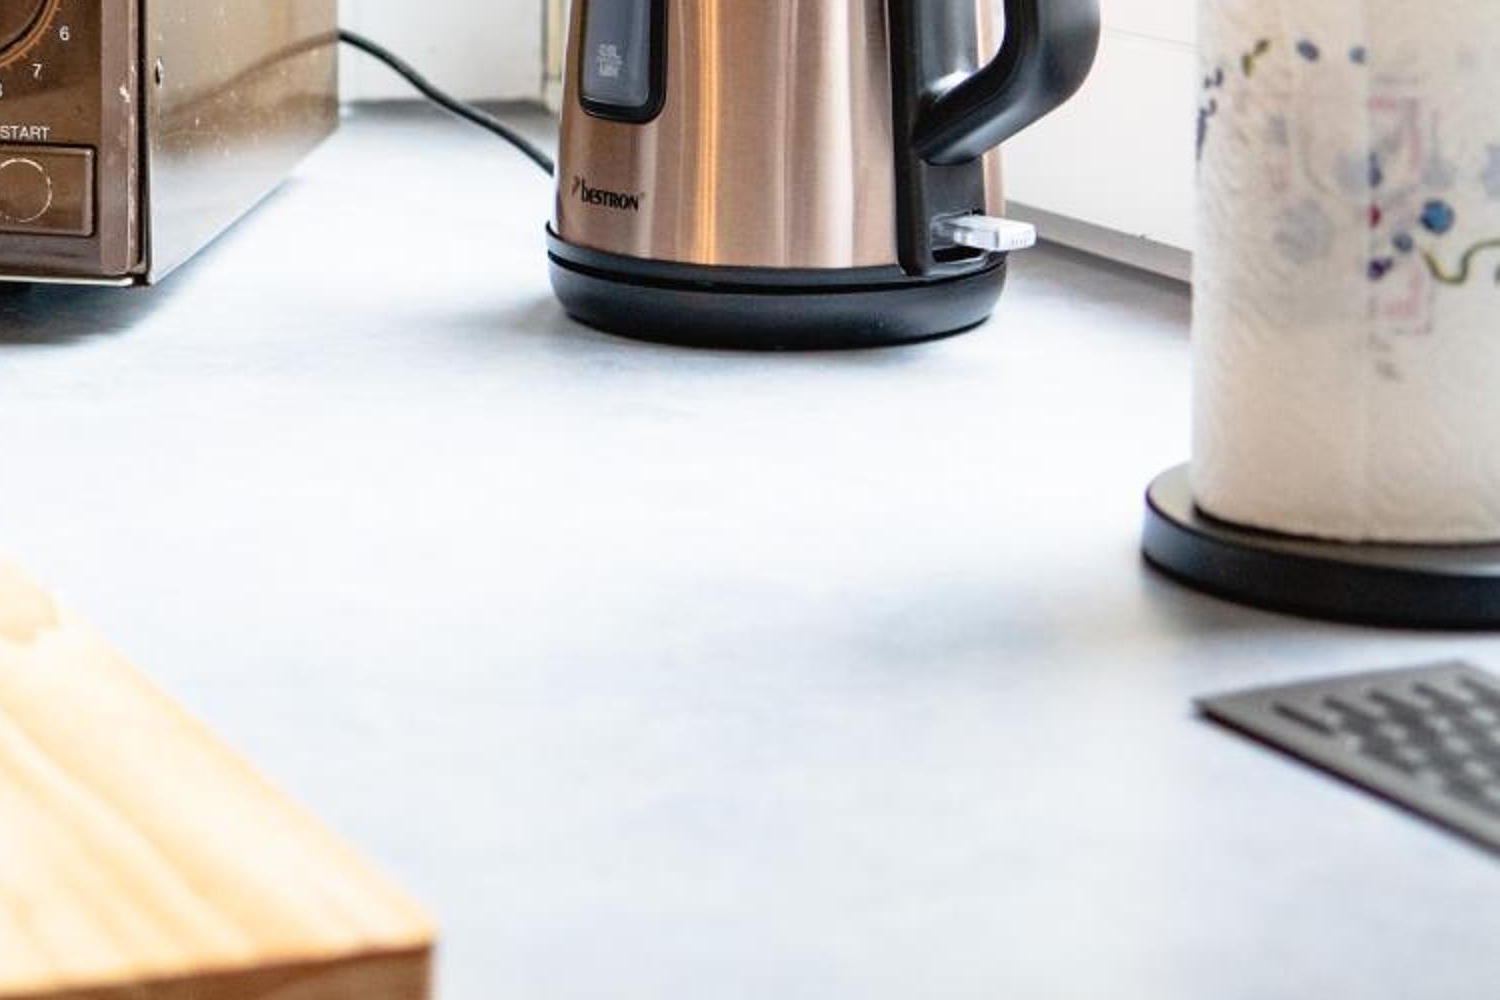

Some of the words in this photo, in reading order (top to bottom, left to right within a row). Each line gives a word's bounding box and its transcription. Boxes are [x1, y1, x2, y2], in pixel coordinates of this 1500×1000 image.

[59, 26, 70, 41] 6
[32, 64, 43, 77] 7
[0, 126, 50, 141] START
